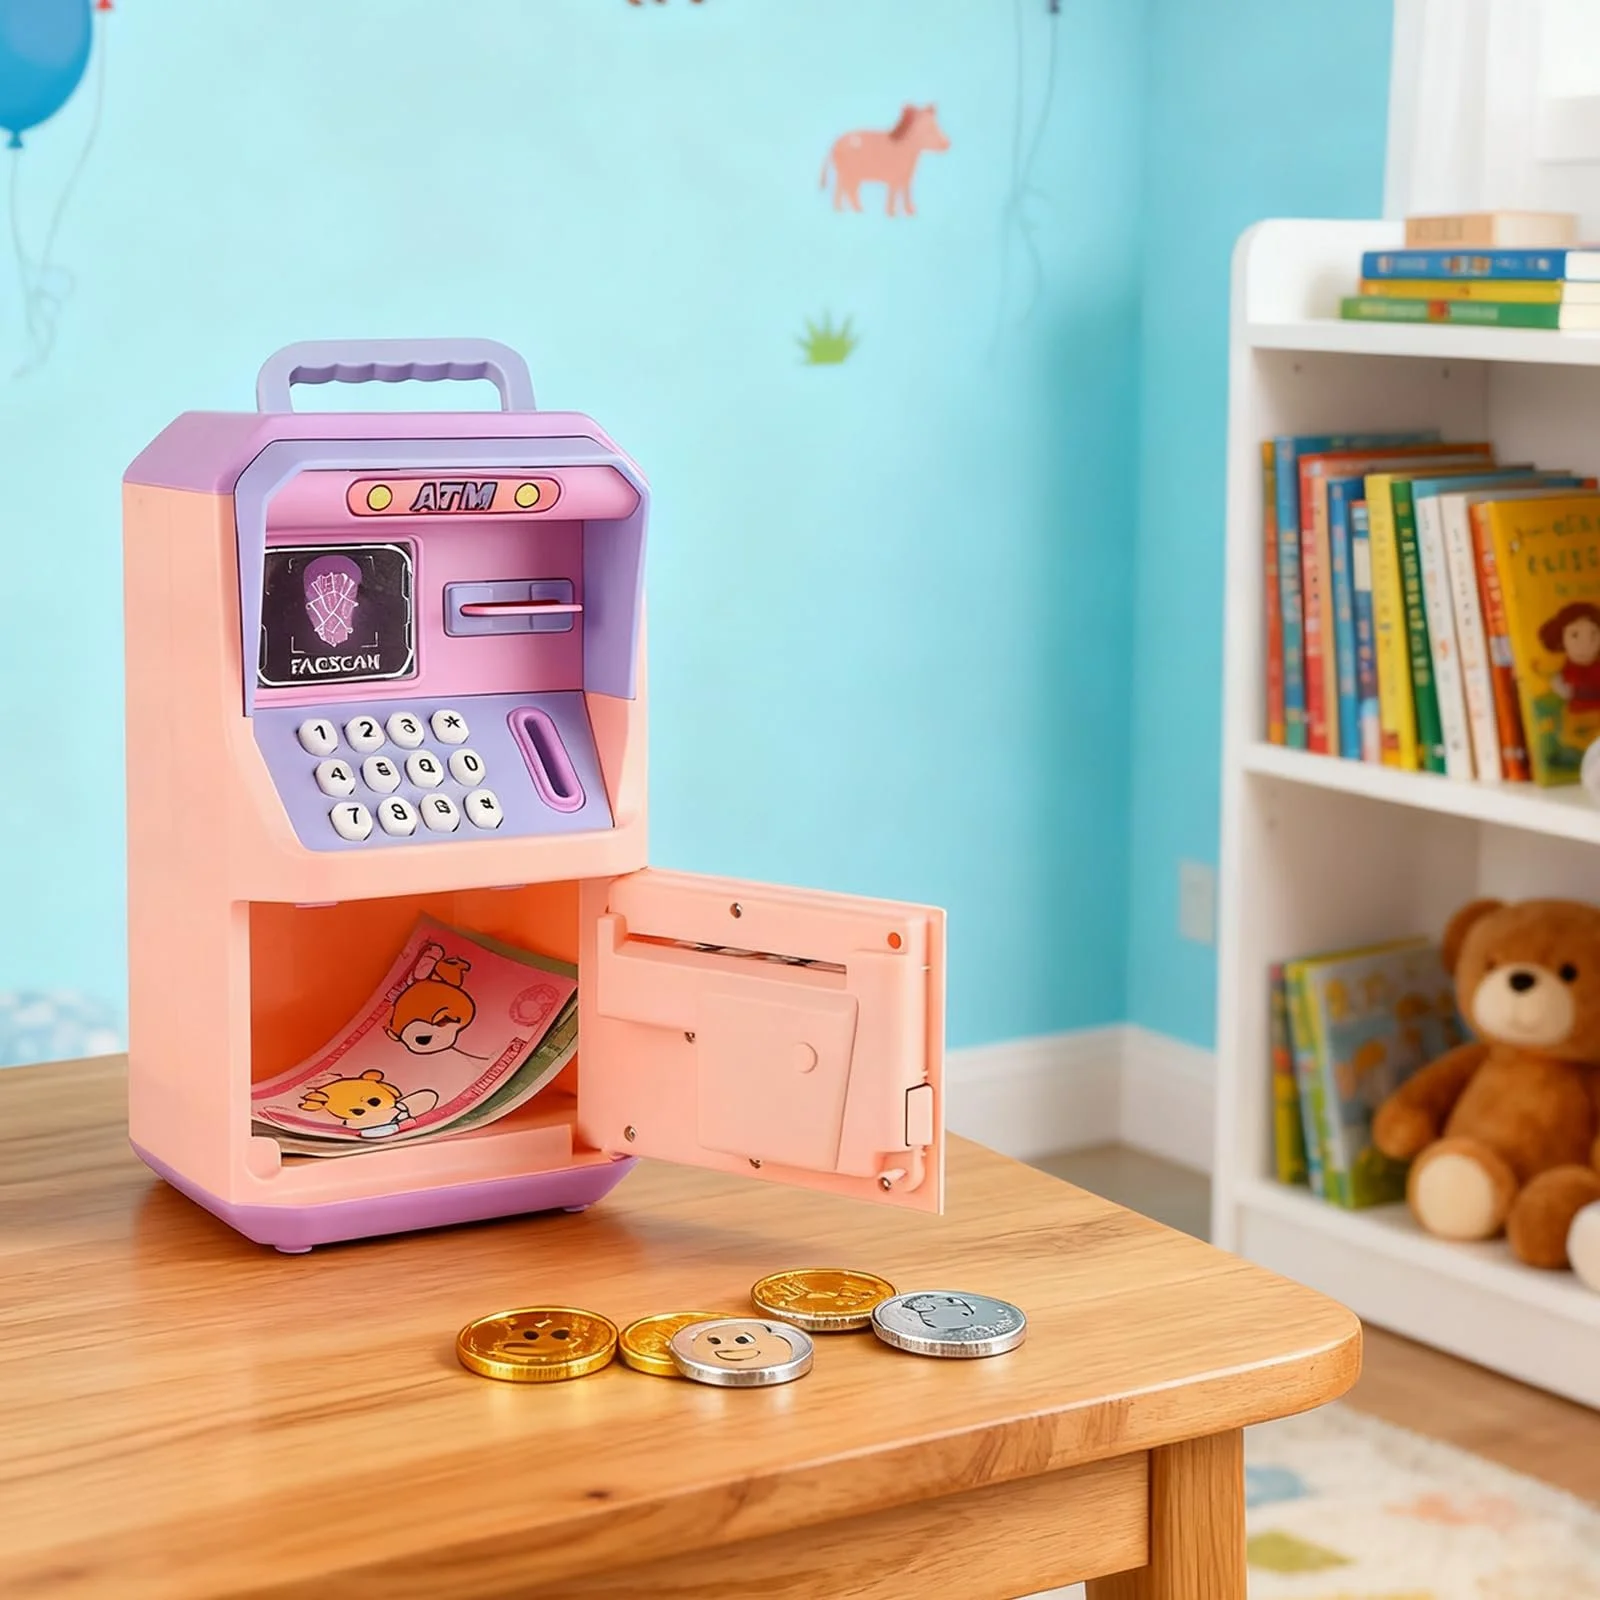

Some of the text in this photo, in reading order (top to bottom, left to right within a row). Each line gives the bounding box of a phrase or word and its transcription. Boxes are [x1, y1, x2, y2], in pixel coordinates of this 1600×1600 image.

[409, 481, 498, 512] ATM
[314, 724, 327, 740] 1
[359, 720, 374, 738] 2
[347, 807, 360, 825] 7
